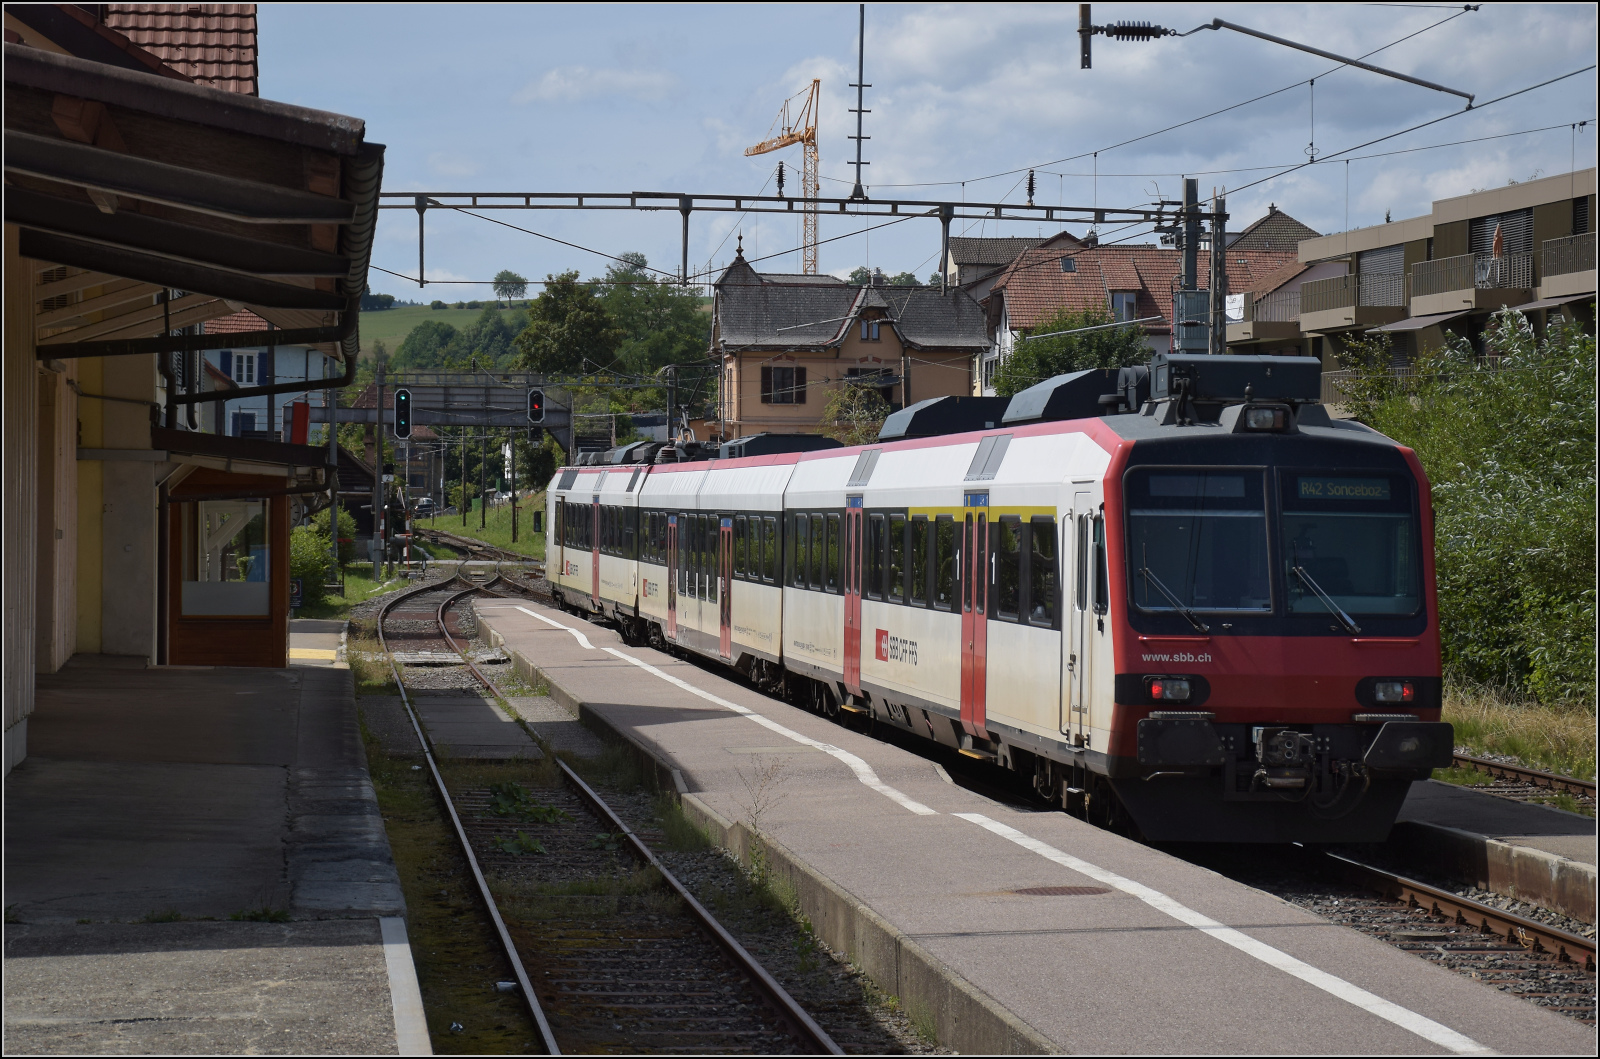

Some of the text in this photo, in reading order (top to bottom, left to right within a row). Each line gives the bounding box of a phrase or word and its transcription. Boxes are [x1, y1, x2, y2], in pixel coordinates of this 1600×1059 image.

[1301, 482, 1322, 495] R42
[889, 635, 918, 666] SBB CFF FFS
[1141, 652, 1212, 663] www.sbb.ch
